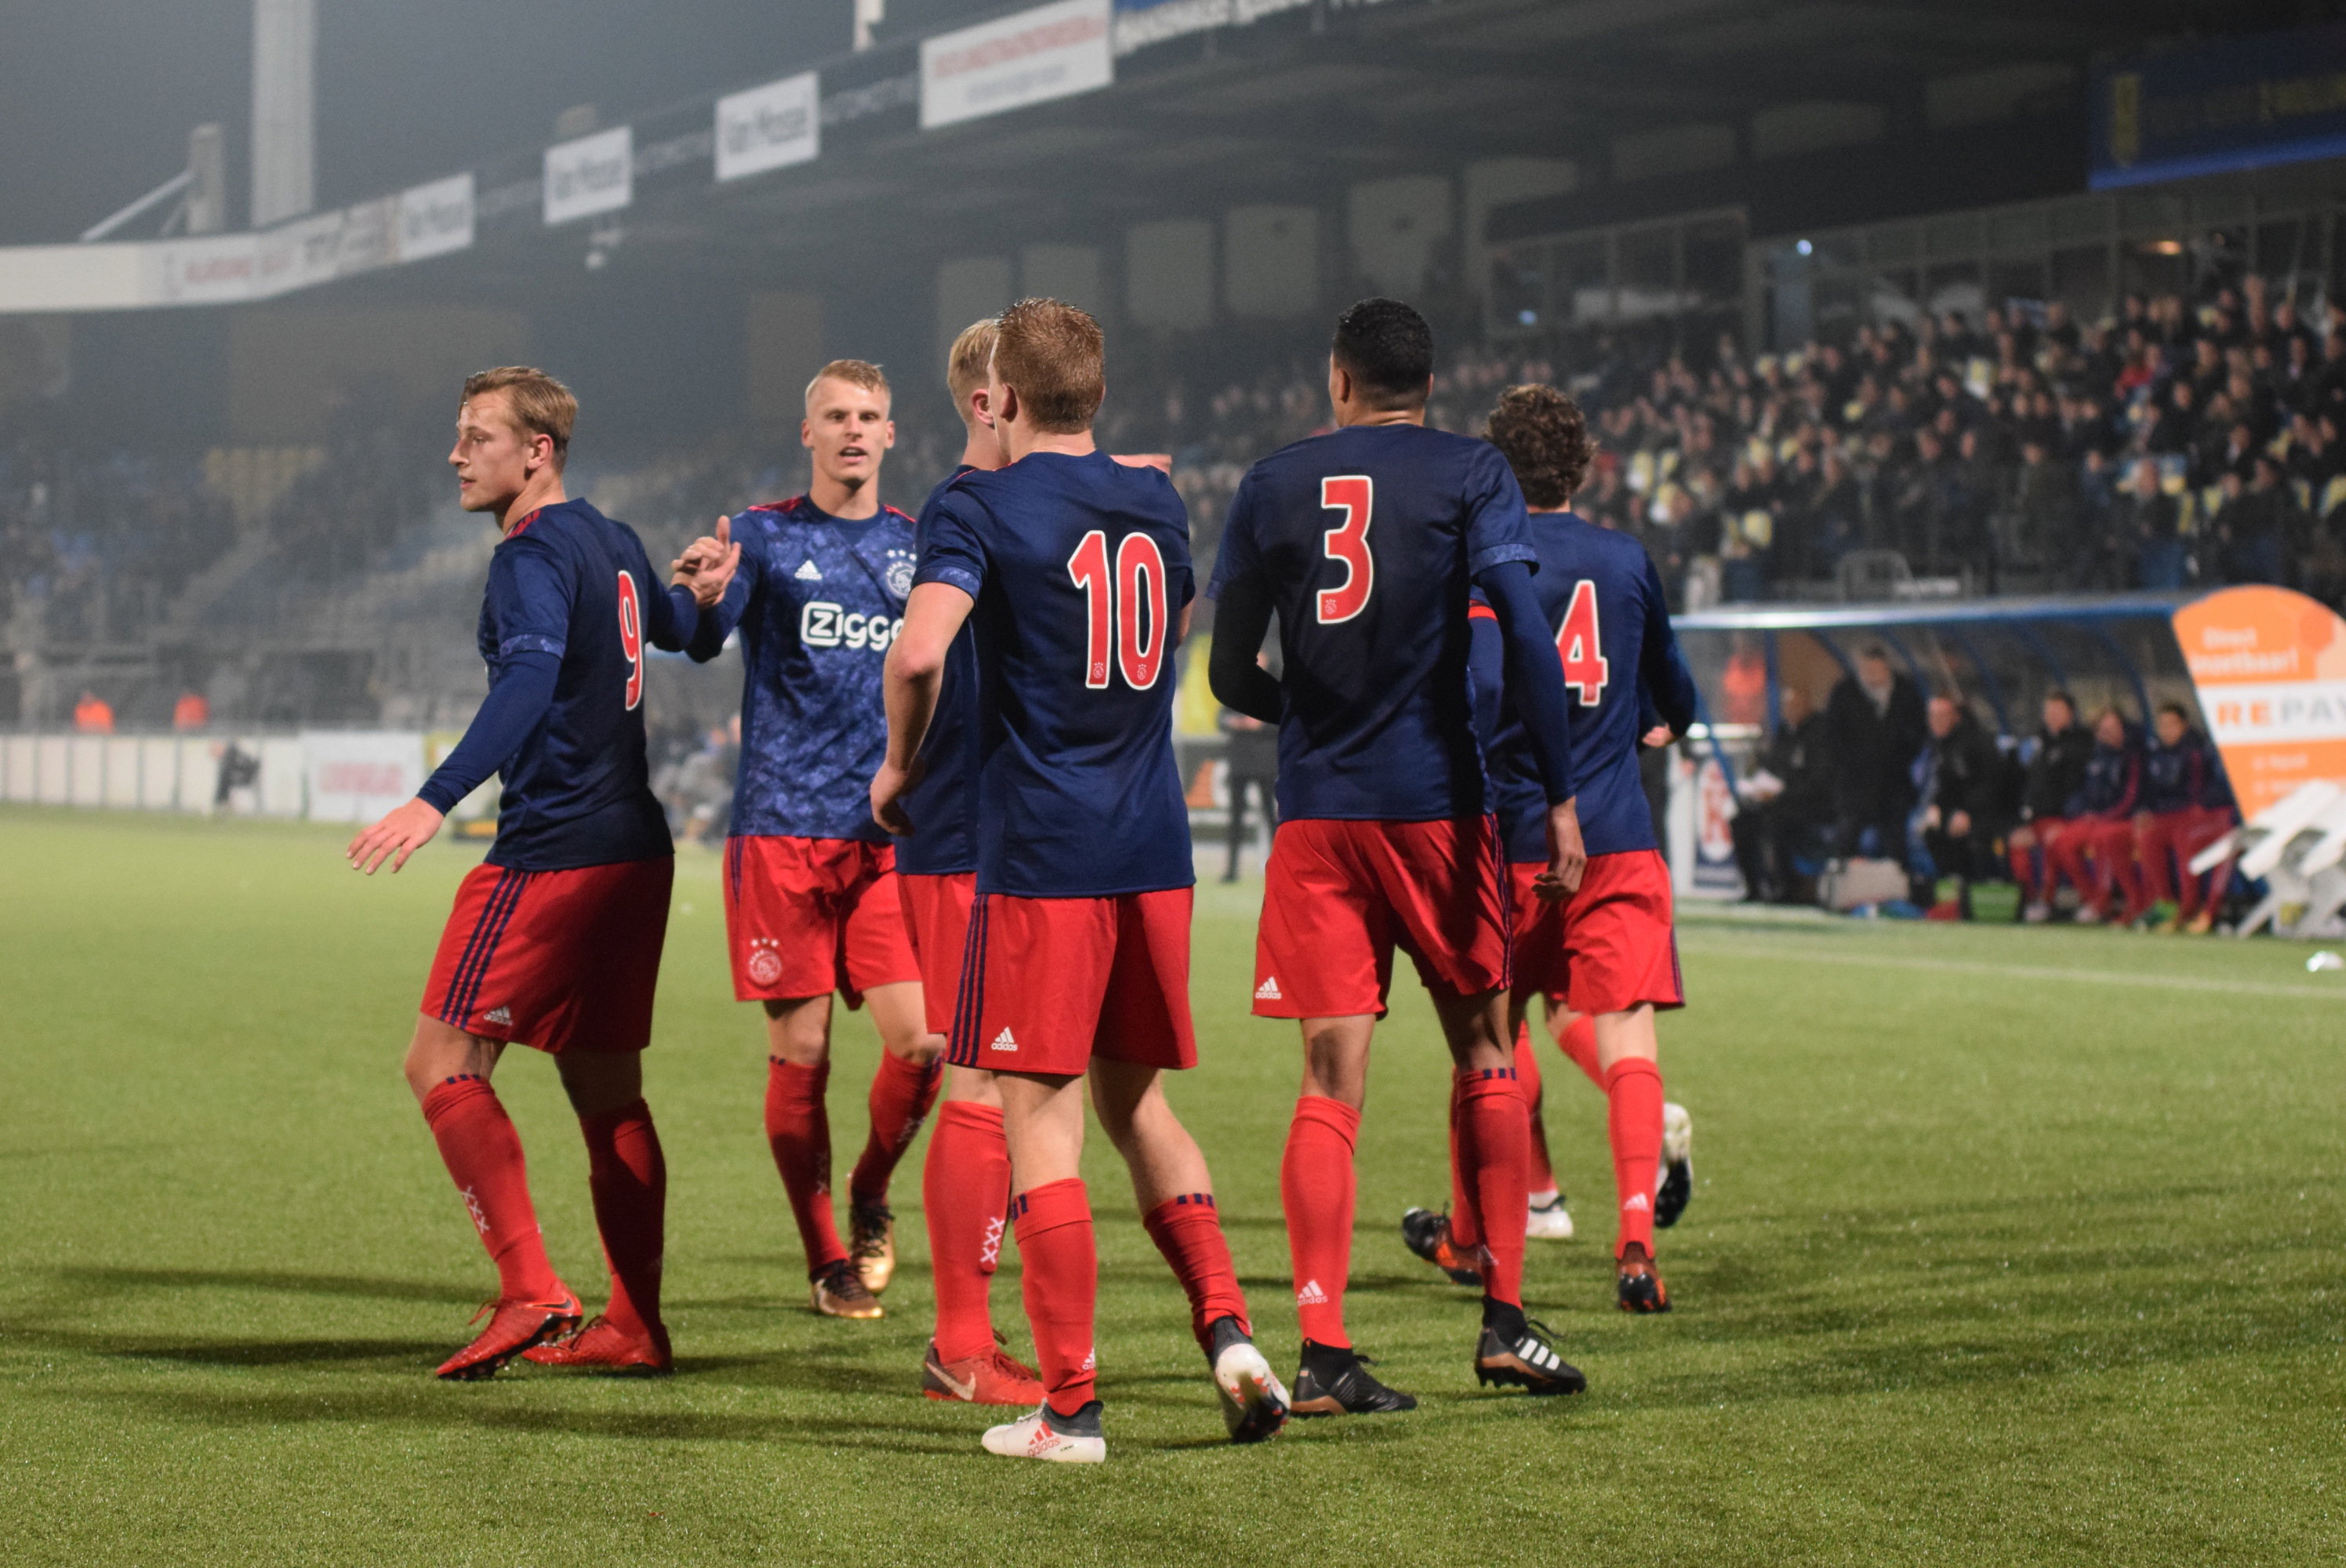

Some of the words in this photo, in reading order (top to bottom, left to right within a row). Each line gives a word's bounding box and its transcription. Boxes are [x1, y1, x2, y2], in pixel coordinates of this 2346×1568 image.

[1067, 530, 1168, 690] 10
[1316, 474, 1374, 624] 3
[618, 569, 643, 711] 9
[1555, 579, 1608, 706] 4
[991, 1042, 1018, 1051] adidas
[1028, 1437, 1060, 1457] adidas
